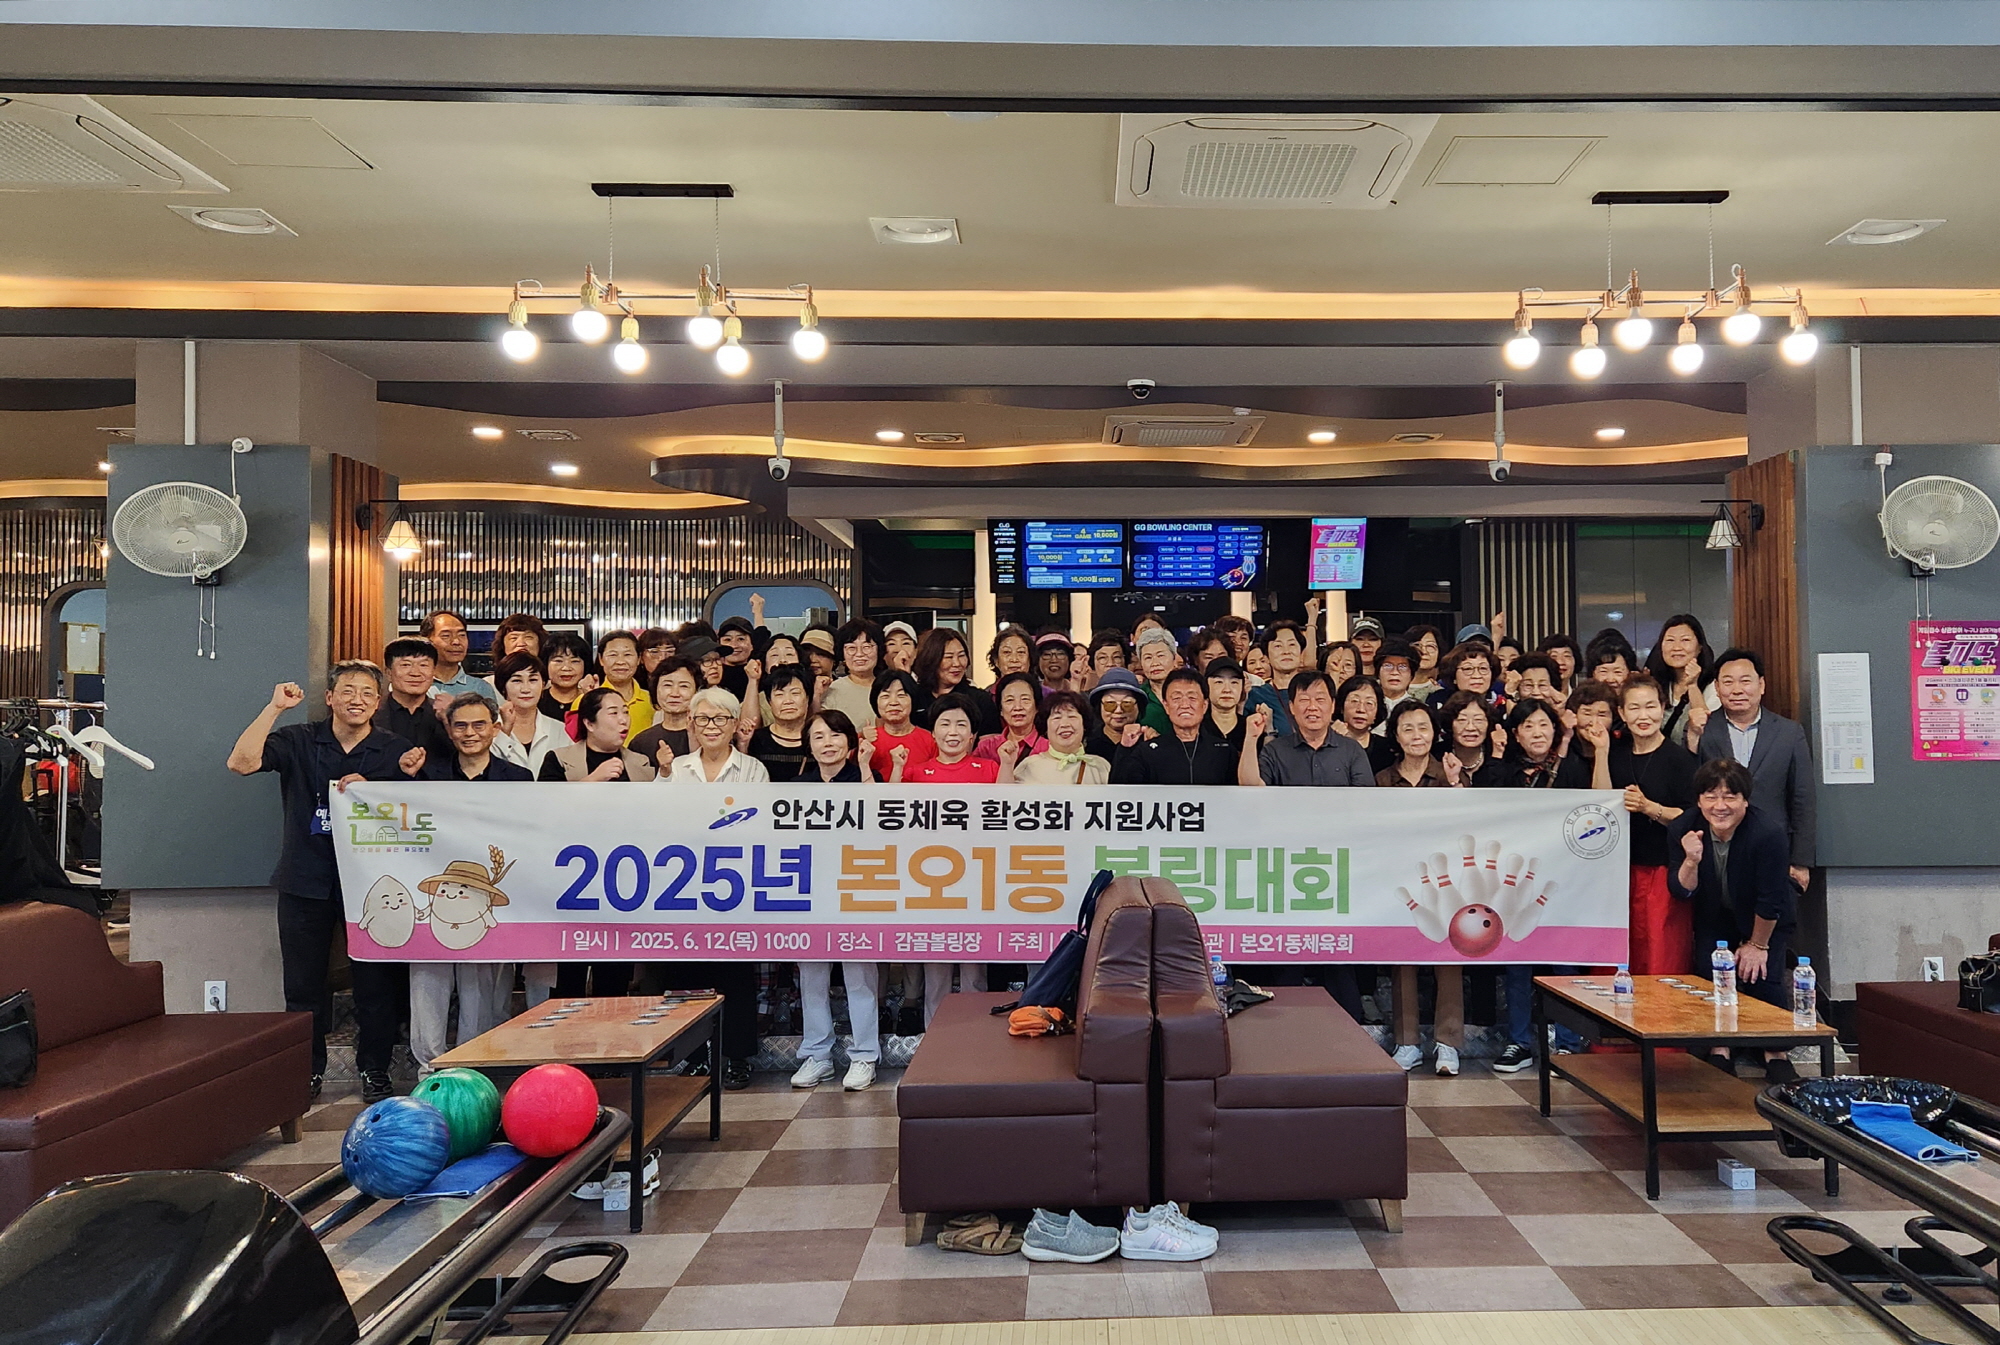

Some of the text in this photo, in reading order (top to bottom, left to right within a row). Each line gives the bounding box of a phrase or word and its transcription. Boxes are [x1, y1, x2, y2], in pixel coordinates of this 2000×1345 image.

[1943, 665, 1996, 674] BIG EVENT
[772, 799, 1205, 832] 안산시 동체육 활성화 지원사업
[554, 844, 812, 912] 2025년
[836, 844, 1068, 913] 본오1동
[573, 931, 811, 952] 일시 2025. 6. 12.(목) 10:00
[838, 932, 982, 952] 장소 감골볼링장
[1008, 932, 1043, 952] 주최
[1240, 933, 1354, 954] 본오1동체육회
